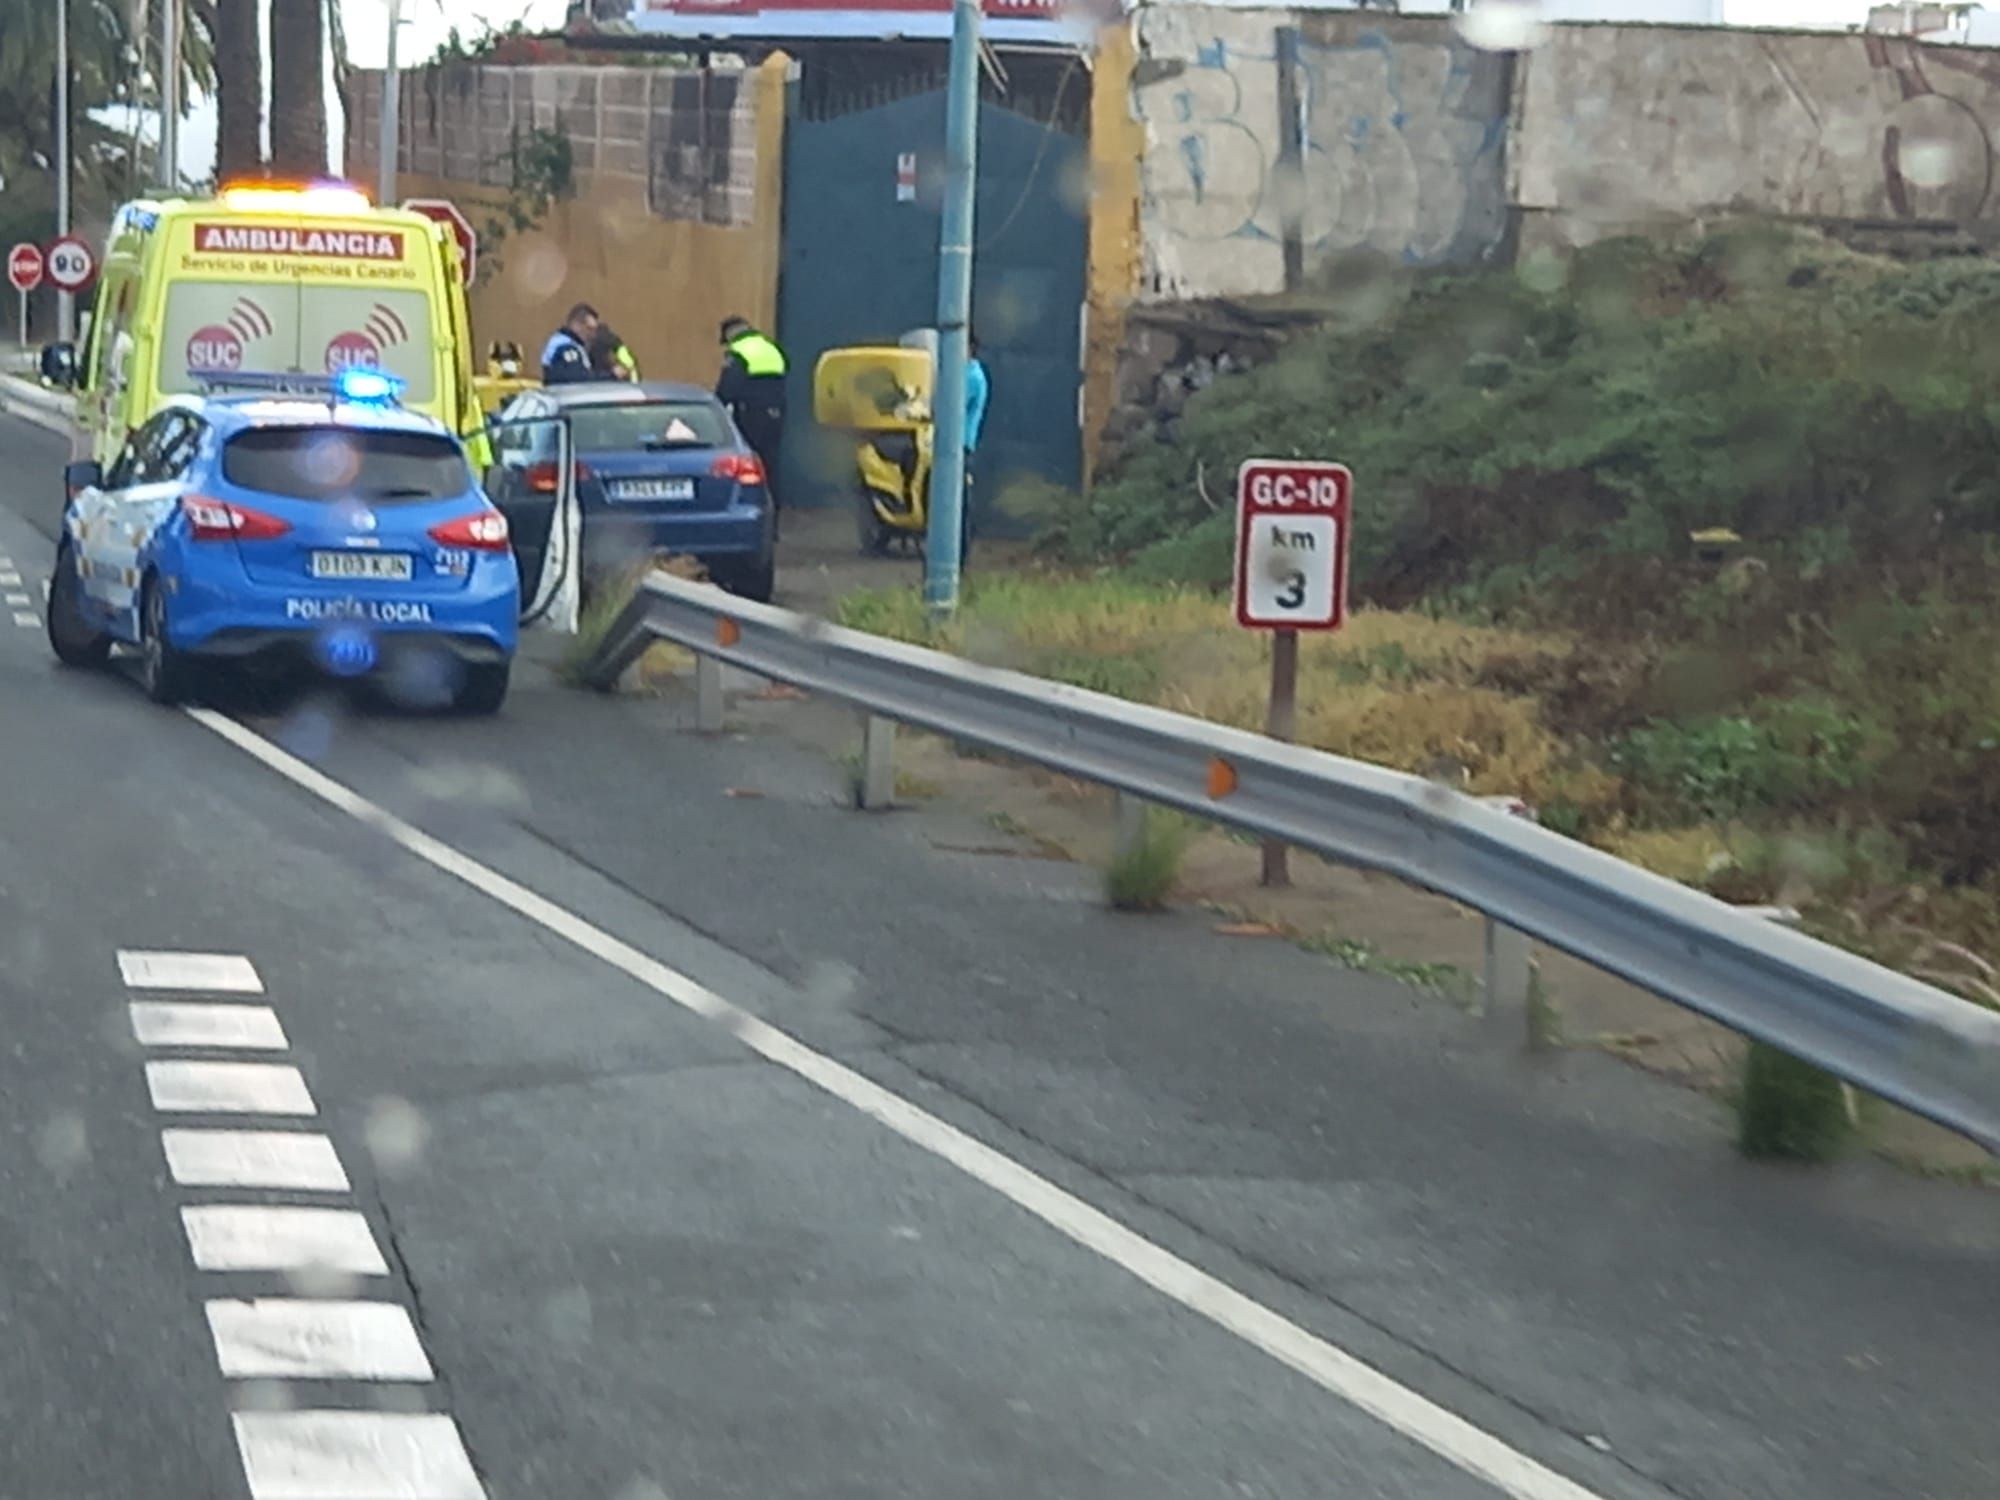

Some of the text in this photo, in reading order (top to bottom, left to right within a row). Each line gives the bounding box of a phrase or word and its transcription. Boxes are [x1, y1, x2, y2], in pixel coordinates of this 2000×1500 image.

[205, 228, 396, 256] AMBULANCIA
[55, 254, 85, 274] 90
[181, 256, 416, 279] Servicio de Urgencias Canario
[190, 341, 241, 369] SUC
[328, 347, 378, 374] SUC
[1251, 475, 1339, 508] GC-10
[1271, 525, 1316, 552] km
[1275, 569, 1307, 609] 3
[286, 595, 432, 623] POLICÍA LOCAL
